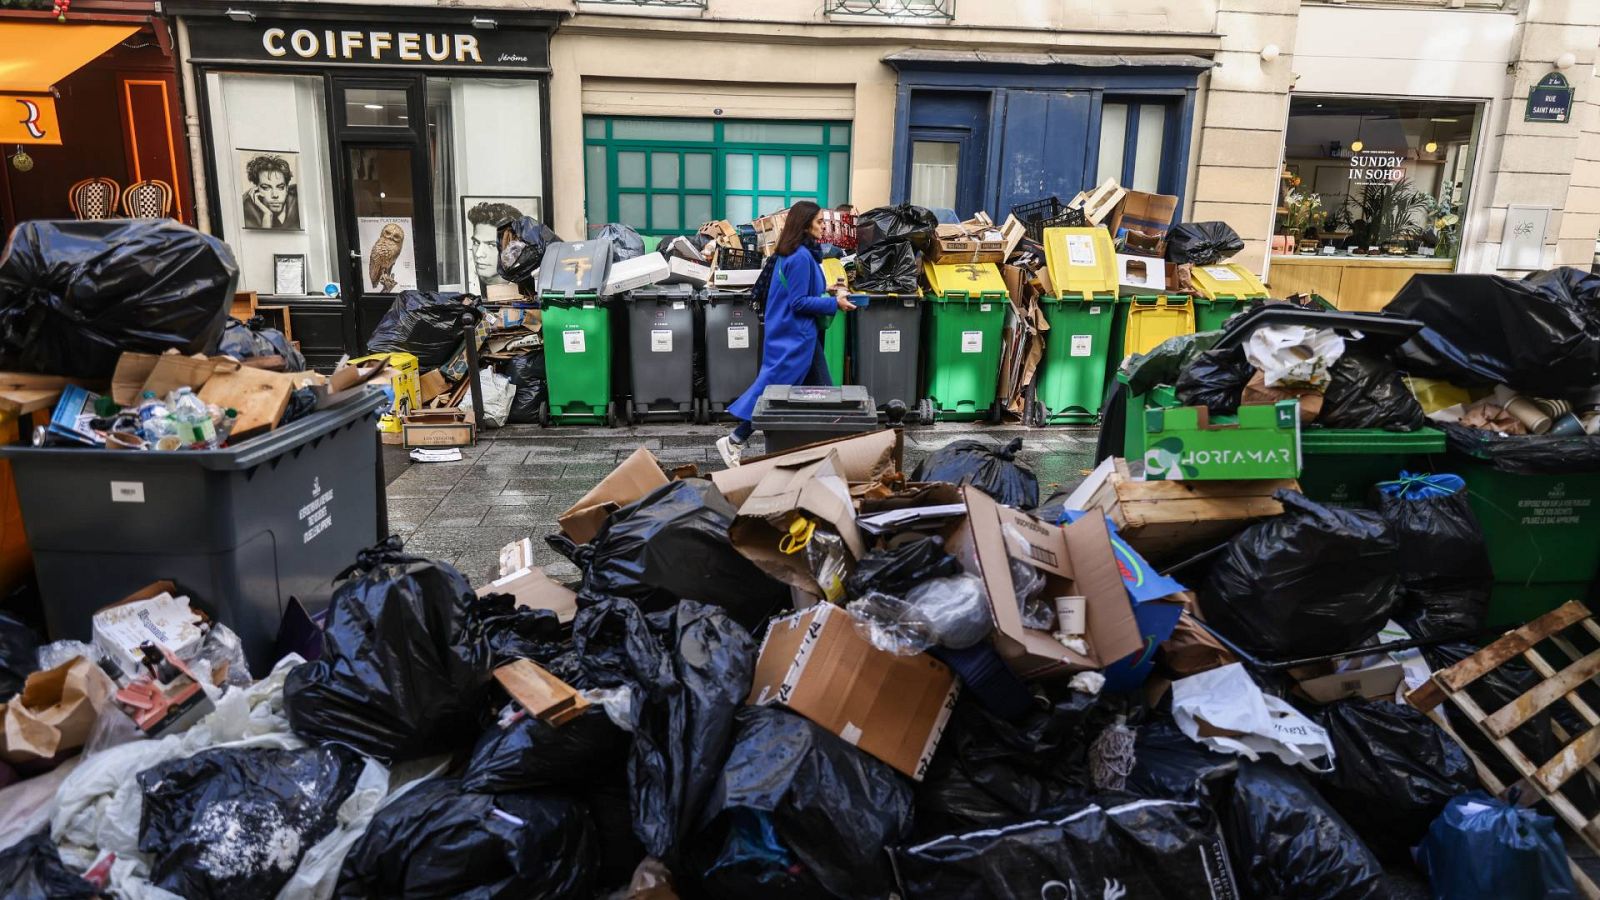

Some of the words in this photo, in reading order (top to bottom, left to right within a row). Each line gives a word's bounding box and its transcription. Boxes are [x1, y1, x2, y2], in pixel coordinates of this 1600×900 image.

[262, 27, 483, 63] COIFFEUR
[498, 53, 528, 63] Jérôme
[16, 99, 46, 139] R
[1348, 168, 1363, 179] IN
[1365, 169, 1402, 180] SOHO
